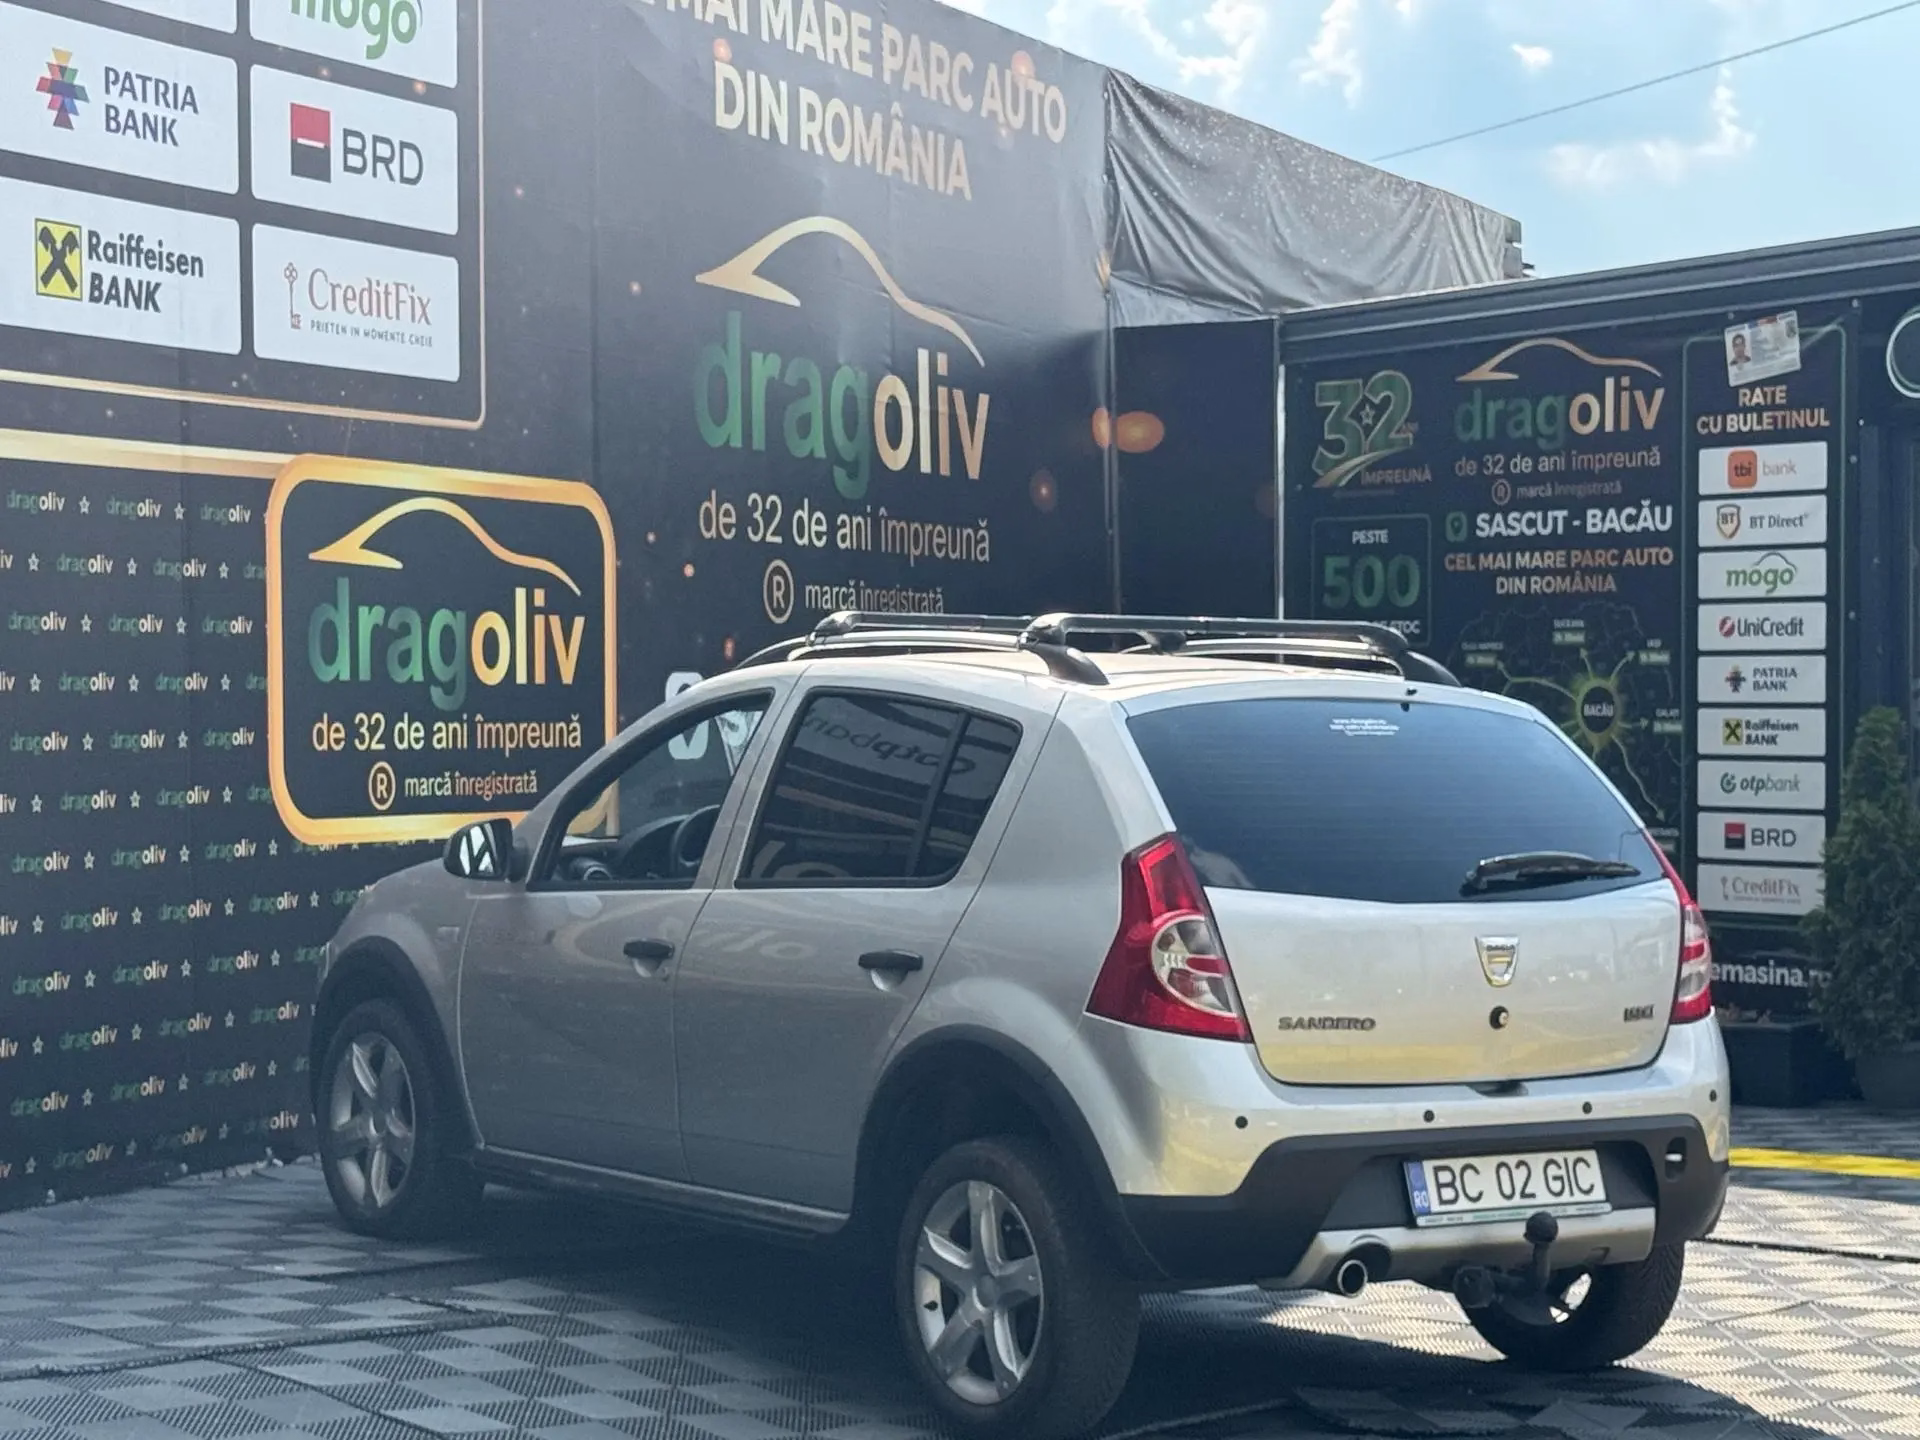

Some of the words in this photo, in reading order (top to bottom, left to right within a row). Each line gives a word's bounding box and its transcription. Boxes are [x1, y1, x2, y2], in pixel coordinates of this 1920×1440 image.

[760, 0, 873, 78] MARE
[882, 23, 974, 114] PARC
[980, 62, 1066, 144] AUTO
[104, 66, 200, 115] PATRIA
[104, 104, 180, 148] BANK
[715, 60, 789, 146] DIN
[799, 86, 973, 201] ROMÂNIA
[342, 127, 424, 187] BRD
[87, 229, 204, 279] Raiffeisen
[87, 272, 162, 314] BANK
[308, 267, 432, 326] CreditFix
[696, 310, 990, 500] dragoliv
[1738, 385, 1788, 408] RATE
[1312, 370, 1413, 477] 32
[1453, 377, 1666, 450] dragoliv
[1696, 416, 1723, 435] CU
[1726, 408, 1831, 434] BULETINUL
[1455, 456, 1478, 477] de
[1482, 454, 1505, 475] 32
[1510, 453, 1533, 474] de
[1538, 451, 1566, 473] ani
[1571, 446, 1661, 474] împreună
[1733, 460, 1753, 478] tbi
[1762, 459, 1797, 477] bank
[6, 491, 65, 515] dragoliv
[106, 498, 161, 521] dragoliv
[200, 505, 251, 525] dragoliv
[1475, 510, 1569, 538] SASCUT
[1585, 499, 1674, 535] BACĂU
[1749, 515, 1765, 530] BT
[699, 489, 737, 541] de
[746, 492, 783, 544] 32
[792, 498, 828, 548] de
[836, 505, 872, 552] ani
[879, 505, 990, 567] împreună
[1352, 529, 1389, 544] PESTE
[56, 554, 113, 577] dragoliv
[153, 558, 206, 581] dragoliv
[1444, 552, 1476, 572] CEL
[1479, 551, 1513, 571] MAI
[1515, 550, 1567, 570] MARE
[1570, 548, 1619, 568] PARC
[1622, 546, 1674, 566] AUTO
[805, 580, 857, 610] marcă
[1323, 553, 1421, 609] 500
[1495, 574, 1527, 595] DIN
[1530, 571, 1618, 594] ROMÂNIA
[1726, 566, 1796, 595] mogo
[8, 611, 67, 635] dragoliv
[108, 614, 163, 637] dragoliv
[202, 617, 253, 637] dragoliv
[1737, 616, 1804, 638] UniCredit
[308, 576, 586, 712] dragoliv
[58, 672, 115, 696] dragoliv
[155, 673, 208, 695] dragoliv
[1752, 667, 1798, 679] PATRIA
[1752, 680, 1788, 692] BANK
[9, 731, 68, 755] dragoliv
[109, 729, 165, 753] dragoliv
[203, 726, 255, 750] dragoliv
[312, 712, 346, 751] de
[354, 711, 386, 751] 32
[393, 712, 425, 750] de
[432, 713, 468, 750] ani
[474, 713, 582, 758] împreună
[1744, 719, 1800, 733] Raiffeisen
[1744, 733, 1780, 746] BANK
[60, 790, 117, 813] dragoliv
[156, 786, 210, 809] dragoliv
[404, 771, 452, 797] marcă
[454, 769, 538, 801] înregistrată
[1740, 773, 1801, 797] otpbank
[1750, 827, 1798, 849] BRD
[11, 850, 70, 876] dragoliv
[111, 845, 167, 870] dragoliv
[204, 838, 256, 862] dragoliv
[1731, 876, 1800, 898] CreditFix
[1277, 1015, 1377, 1031] SANDERO
[1413, 1189, 1430, 1209] RO
[1432, 1163, 1485, 1208] BC
[1494, 1159, 1538, 1202] 02
[1542, 1156, 1597, 1199] GIC
